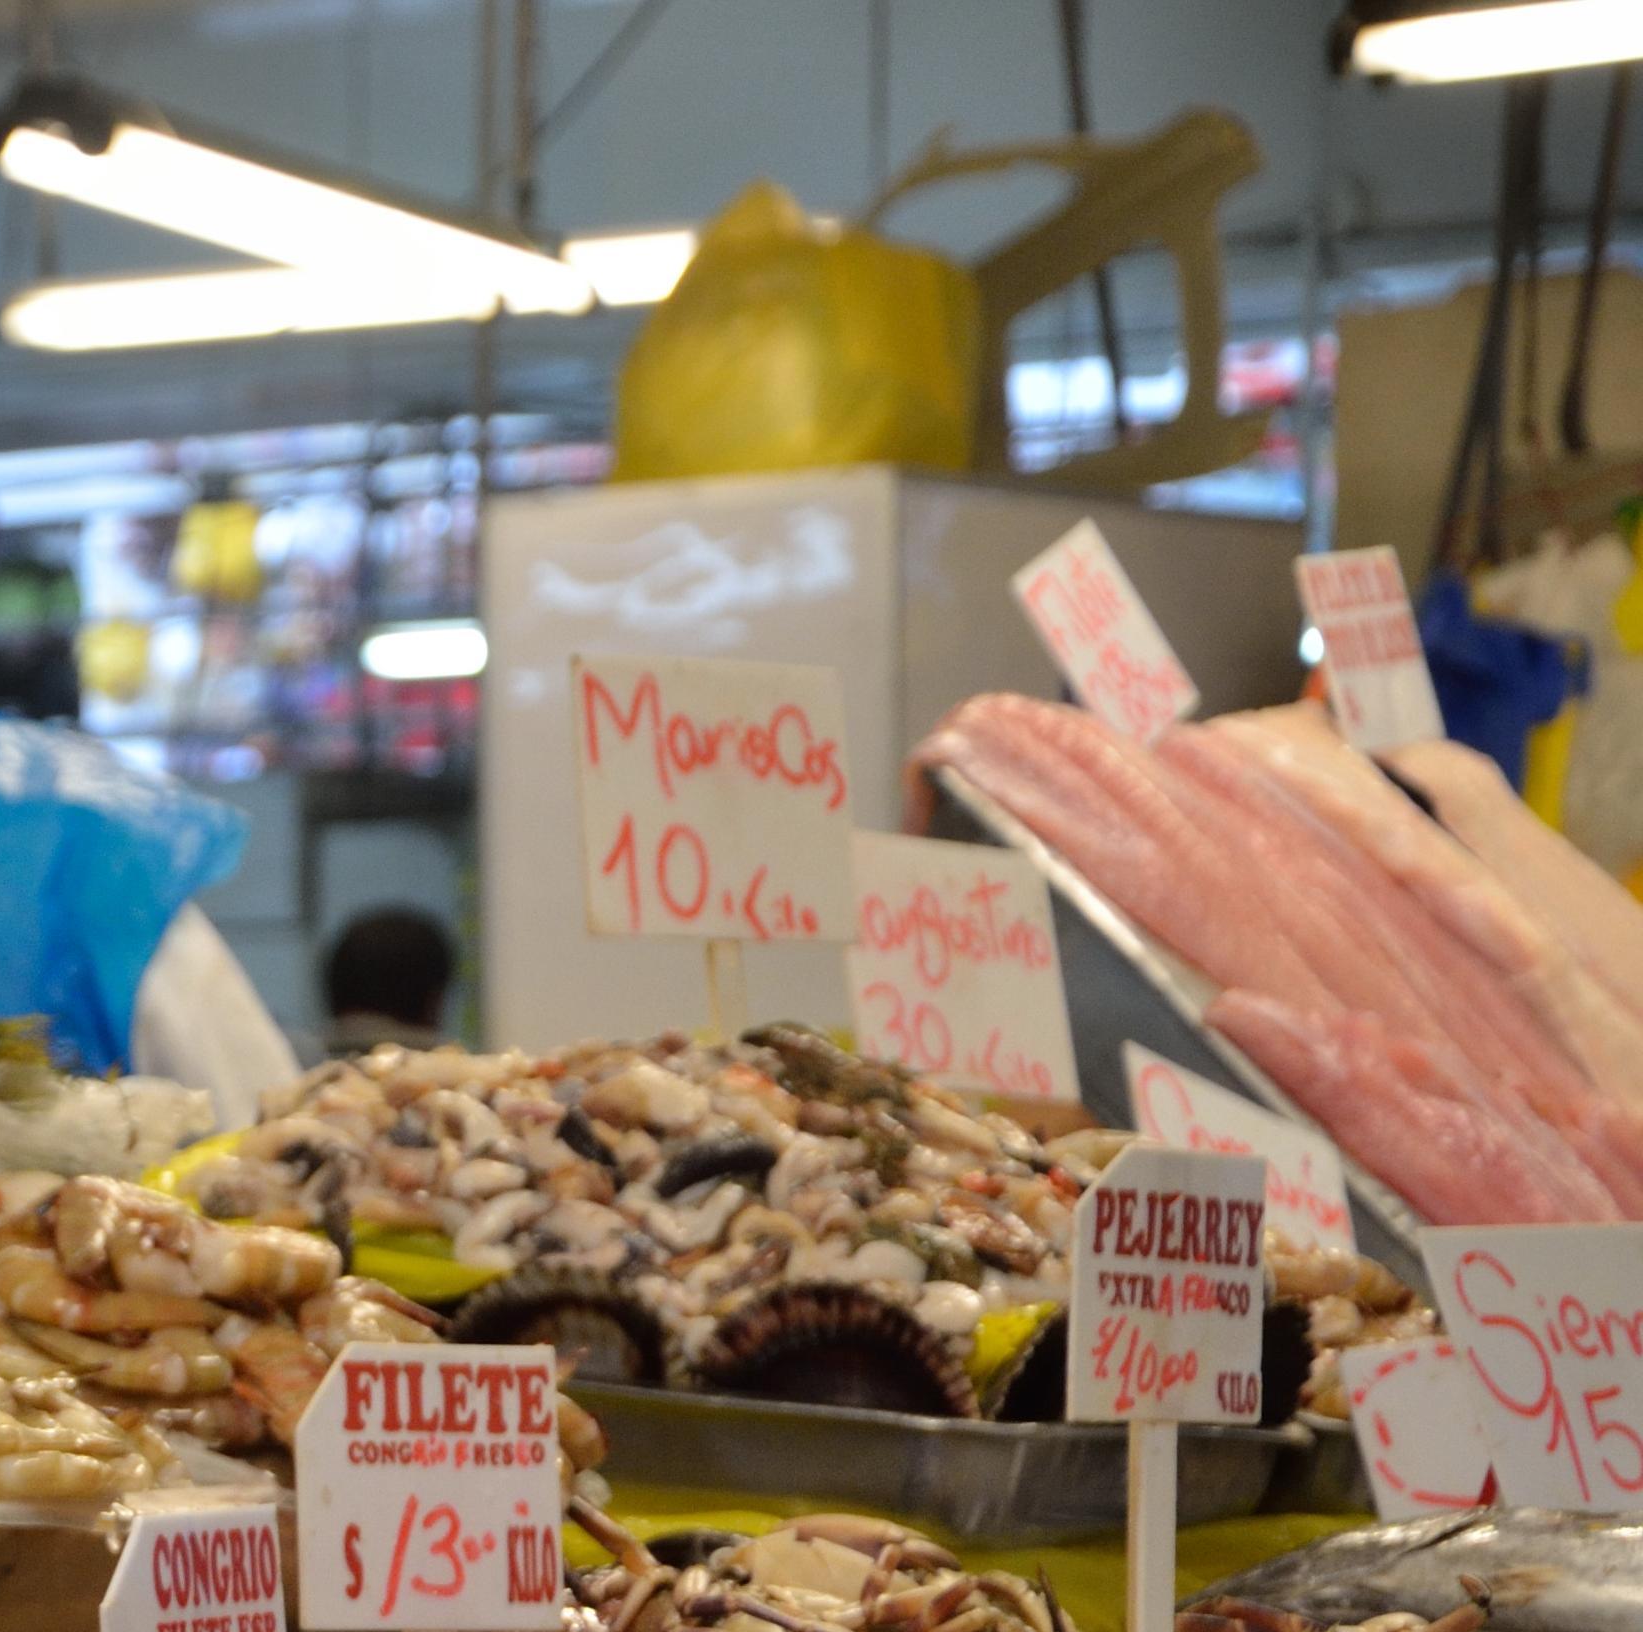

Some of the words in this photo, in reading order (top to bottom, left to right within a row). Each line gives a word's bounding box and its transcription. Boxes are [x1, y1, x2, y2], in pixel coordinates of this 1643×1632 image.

[1093, 1187, 1264, 1268] PEJERREY
[342, 1360, 552, 1435] FILETE
[152, 1525, 277, 1612] CONGRIO
